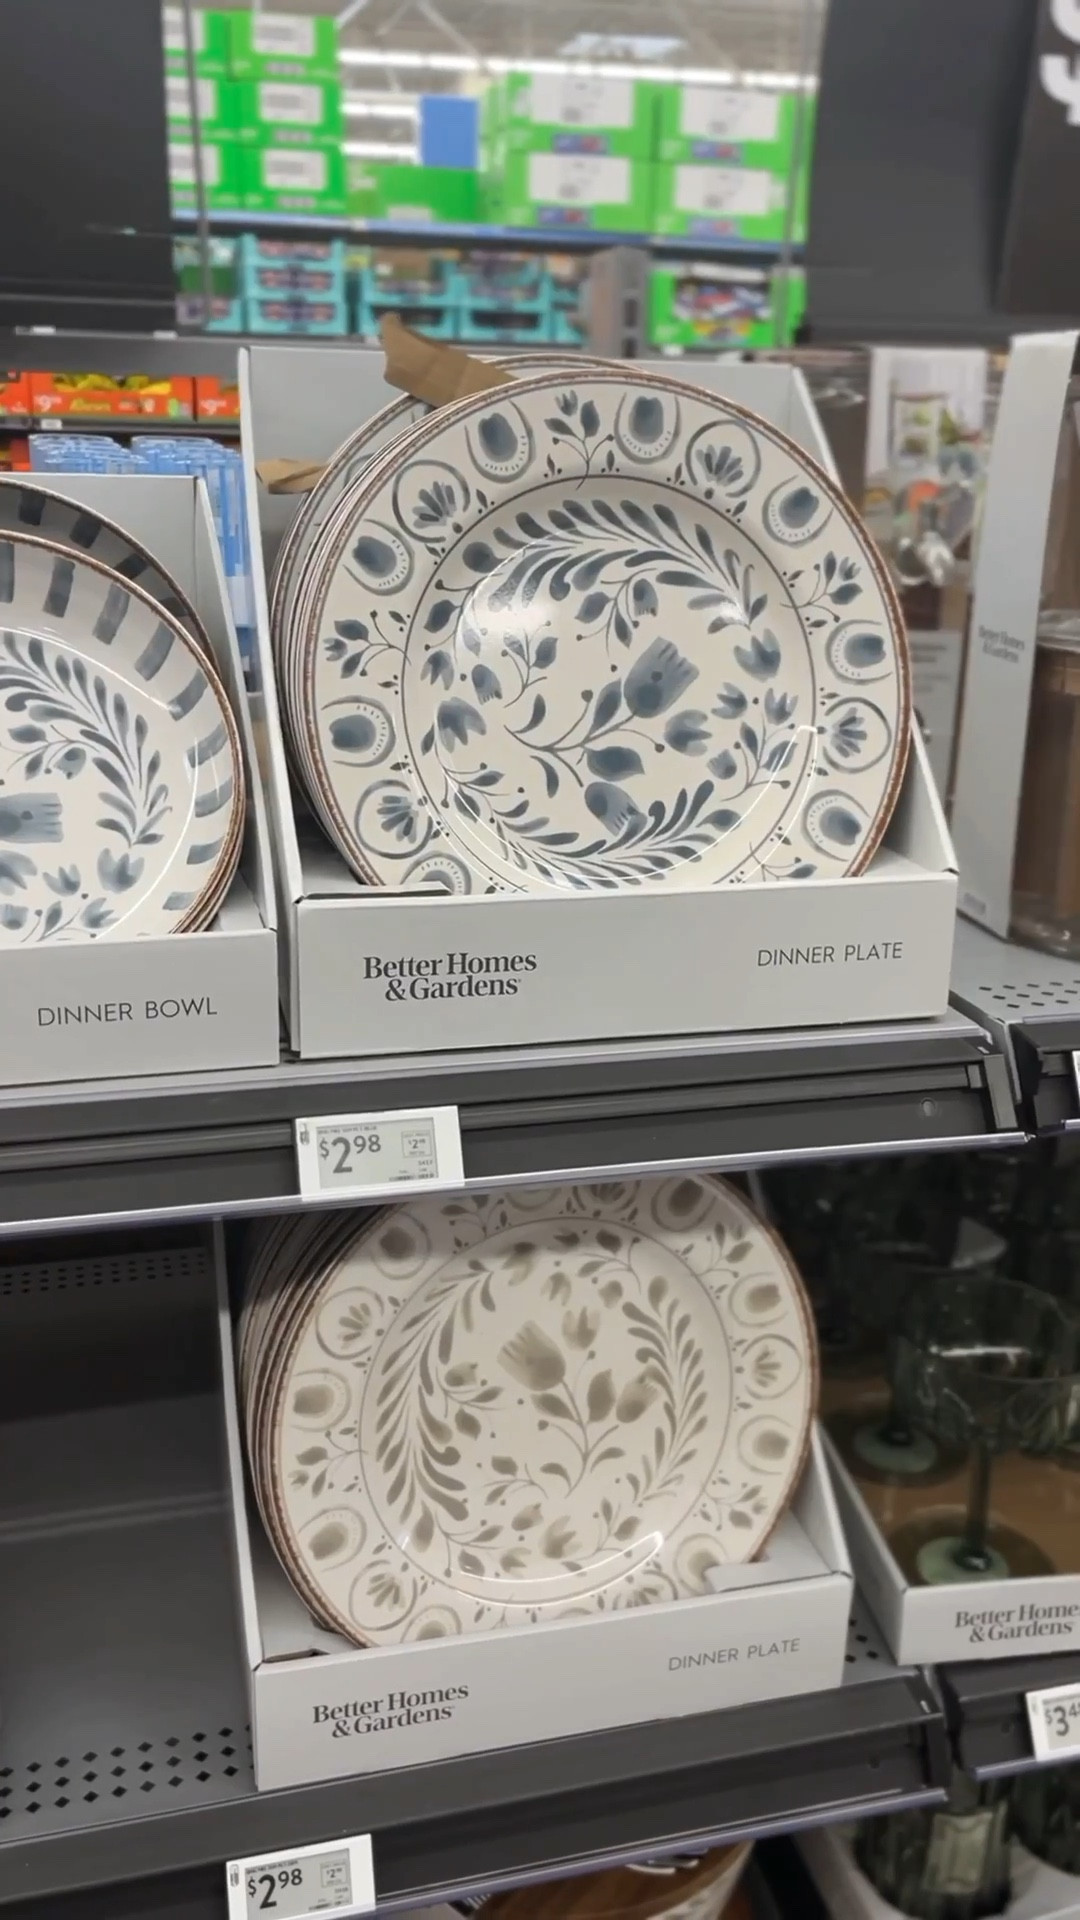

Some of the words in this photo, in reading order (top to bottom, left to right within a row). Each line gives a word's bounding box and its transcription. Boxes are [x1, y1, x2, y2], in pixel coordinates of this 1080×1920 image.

[363, 956, 443, 979] Better
[447, 952, 537, 975] Homes
[757, 946, 835, 966] DINNER
[844, 942, 903, 962] PLATE
[410, 975, 519, 1000] Gardens
[38, 1002, 133, 1026] DINNER
[145, 997, 218, 1019] BOWL
[954, 1611, 1016, 1628] Better
[1019, 1604, 1080, 1621] Home
[988, 1621, 1073, 1641] Gardens
[668, 1648, 739, 1671] DINNER
[747, 1638, 801, 1659] PLATE
[313, 1700, 383, 1723] Better
[387, 1685, 470, 1711] Homes
[354, 1706, 453, 1734] Gardens
